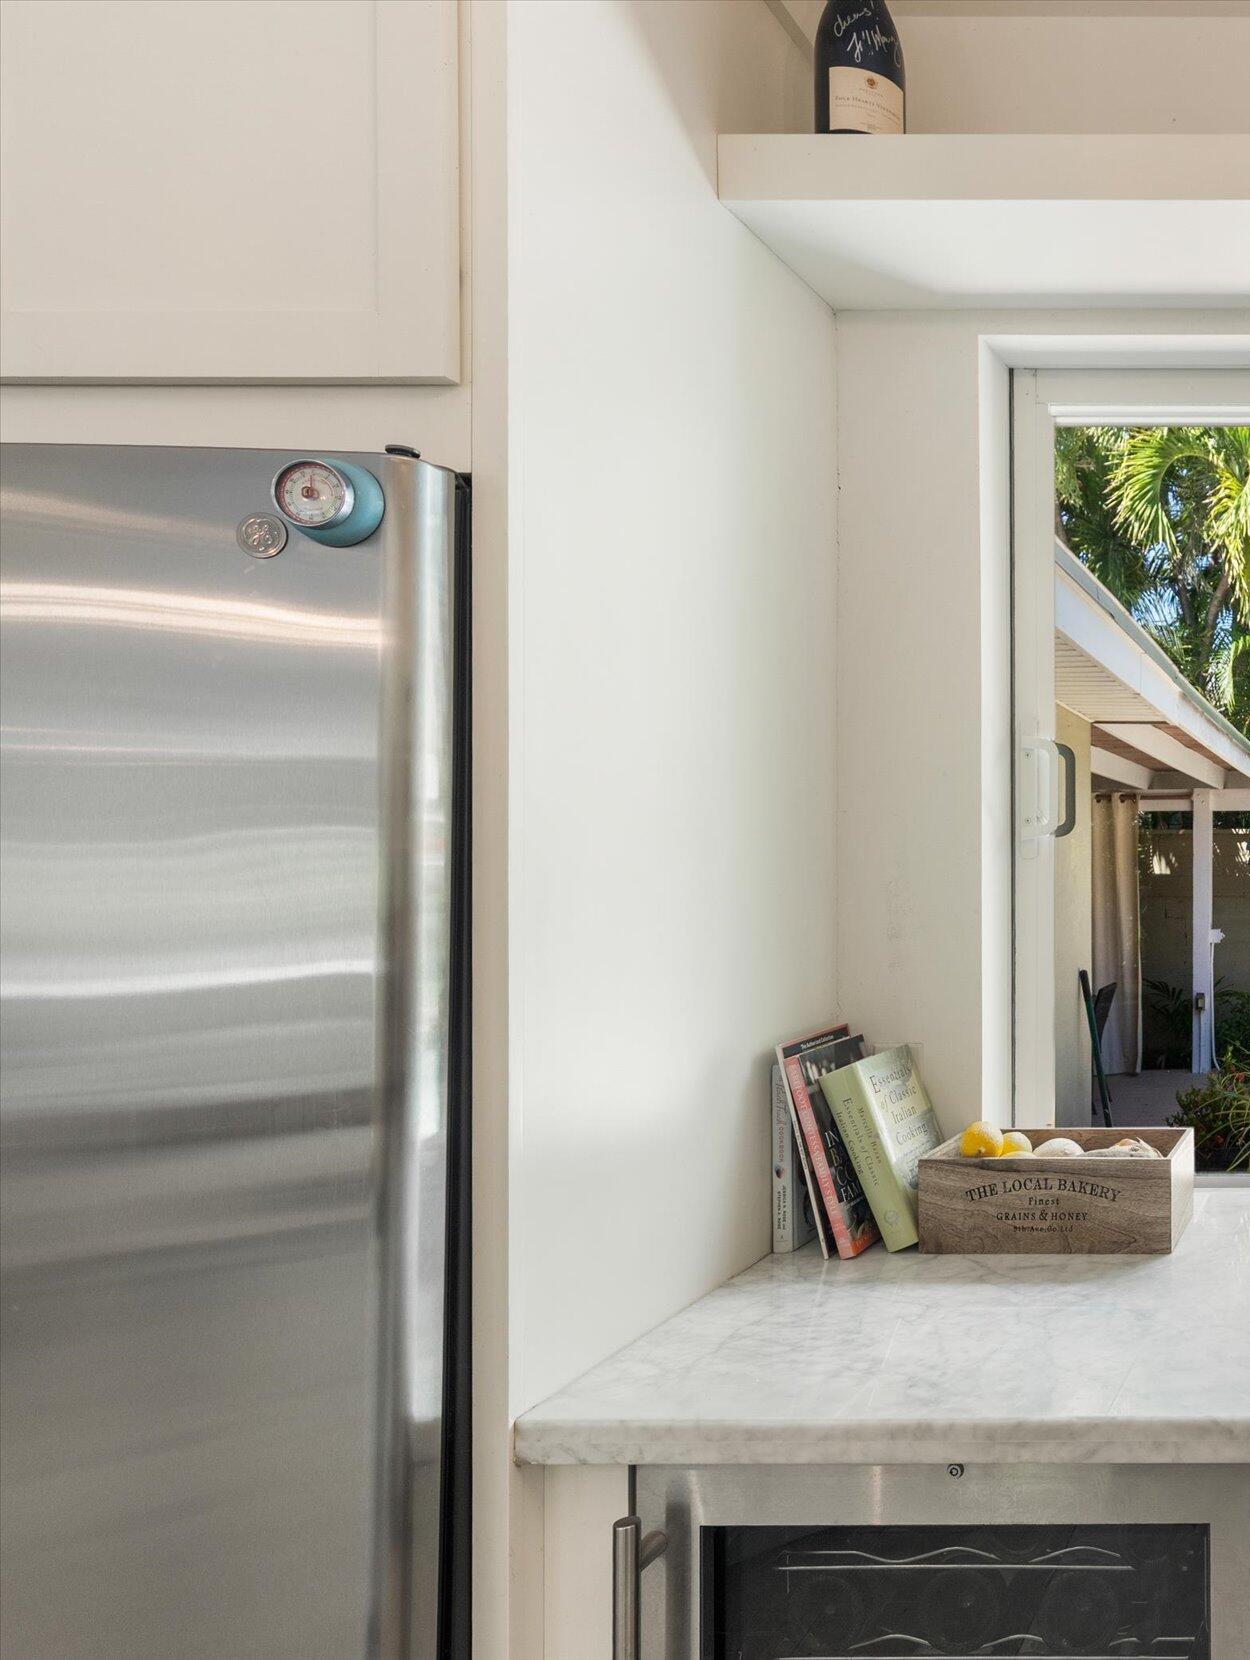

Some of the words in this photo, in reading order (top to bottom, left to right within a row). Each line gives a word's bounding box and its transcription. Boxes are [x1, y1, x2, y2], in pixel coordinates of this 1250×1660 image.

[869, 1063, 912, 1094] Essentials
[889, 1085, 917, 1105] Classic
[891, 1104, 917, 1125] Italian
[895, 1120, 928, 1146] Cooking
[965, 1183, 998, 1202] THE
[1002, 1177, 1053, 1194] LOCAL
[1057, 1178, 1122, 1202] BAKERY
[1028, 1196, 1060, 1206] Finest
[996, 1212, 1036, 1221] GRAINS
[1038, 1209, 1048, 1221] &
[1051, 1212, 1089, 1221] HONEY
